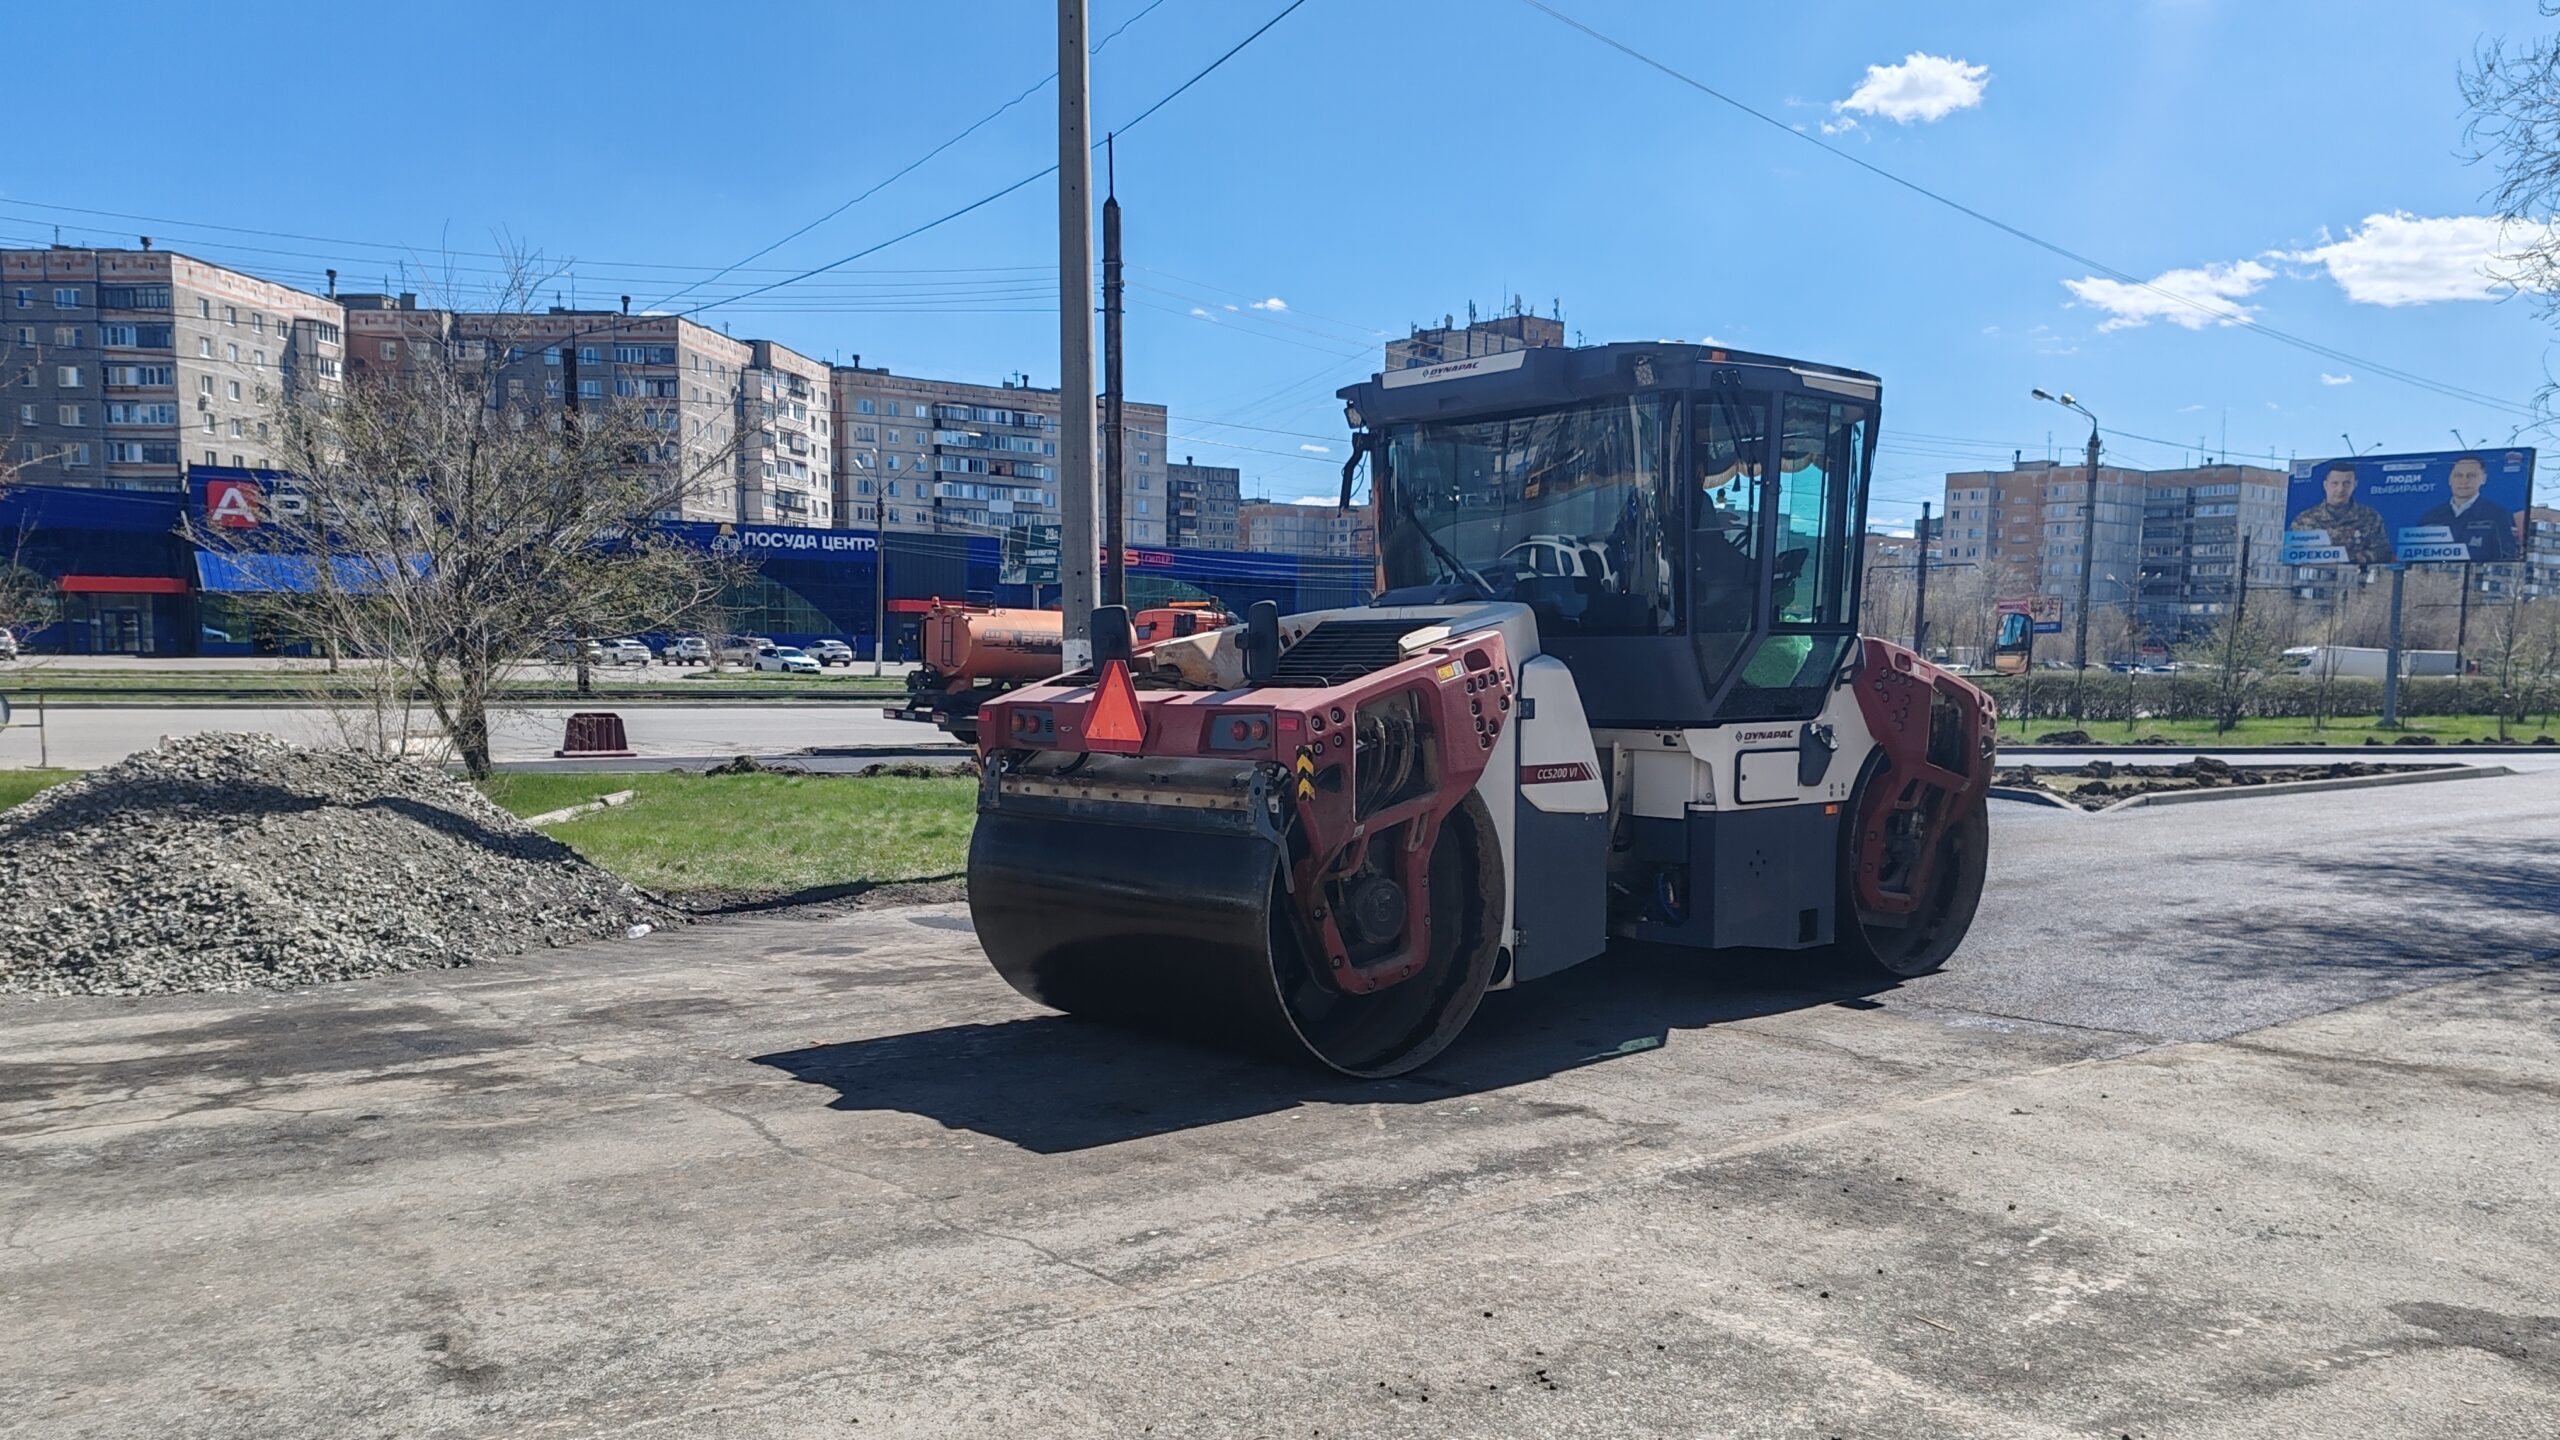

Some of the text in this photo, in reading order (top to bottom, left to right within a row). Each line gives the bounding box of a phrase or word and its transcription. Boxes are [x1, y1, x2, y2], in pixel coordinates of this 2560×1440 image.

[1429, 361, 1479, 376] DYNAPAC
[2385, 475, 2421, 484] ЛЮДИ
[2370, 483, 2435, 494] ВЫБИРАЮТ
[745, 532, 818, 549] ПОСУДА
[2289, 551, 2340, 560] ОРЕХОВ
[2403, 548, 2461, 558] ДРЕМОВ
[1021, 636, 1062, 646] РЕГИ
[1744, 730, 1793, 740] DYNAPAC
